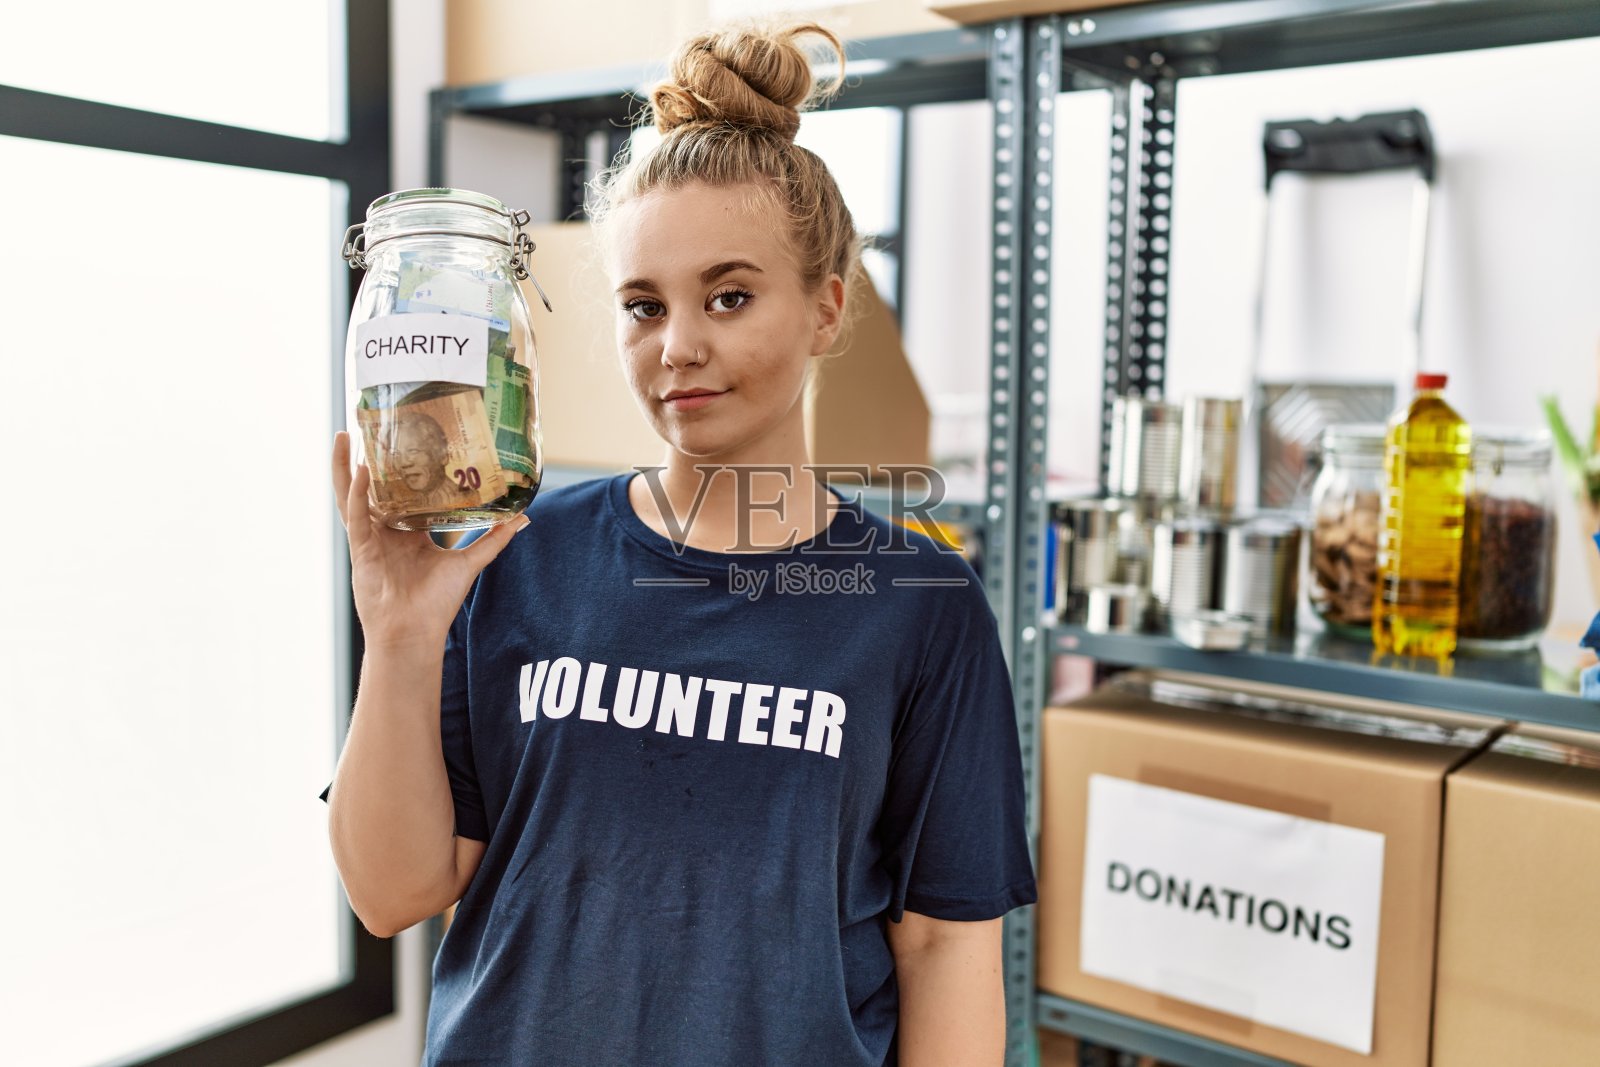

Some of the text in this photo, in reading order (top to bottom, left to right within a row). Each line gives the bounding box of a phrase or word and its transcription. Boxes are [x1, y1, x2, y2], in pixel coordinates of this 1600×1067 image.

[365, 335, 470, 359] CHARITY
[453, 466, 482, 492] 20
[519, 656, 847, 759] VOLUNTEER
[1106, 861, 1352, 950] DONATIONS
